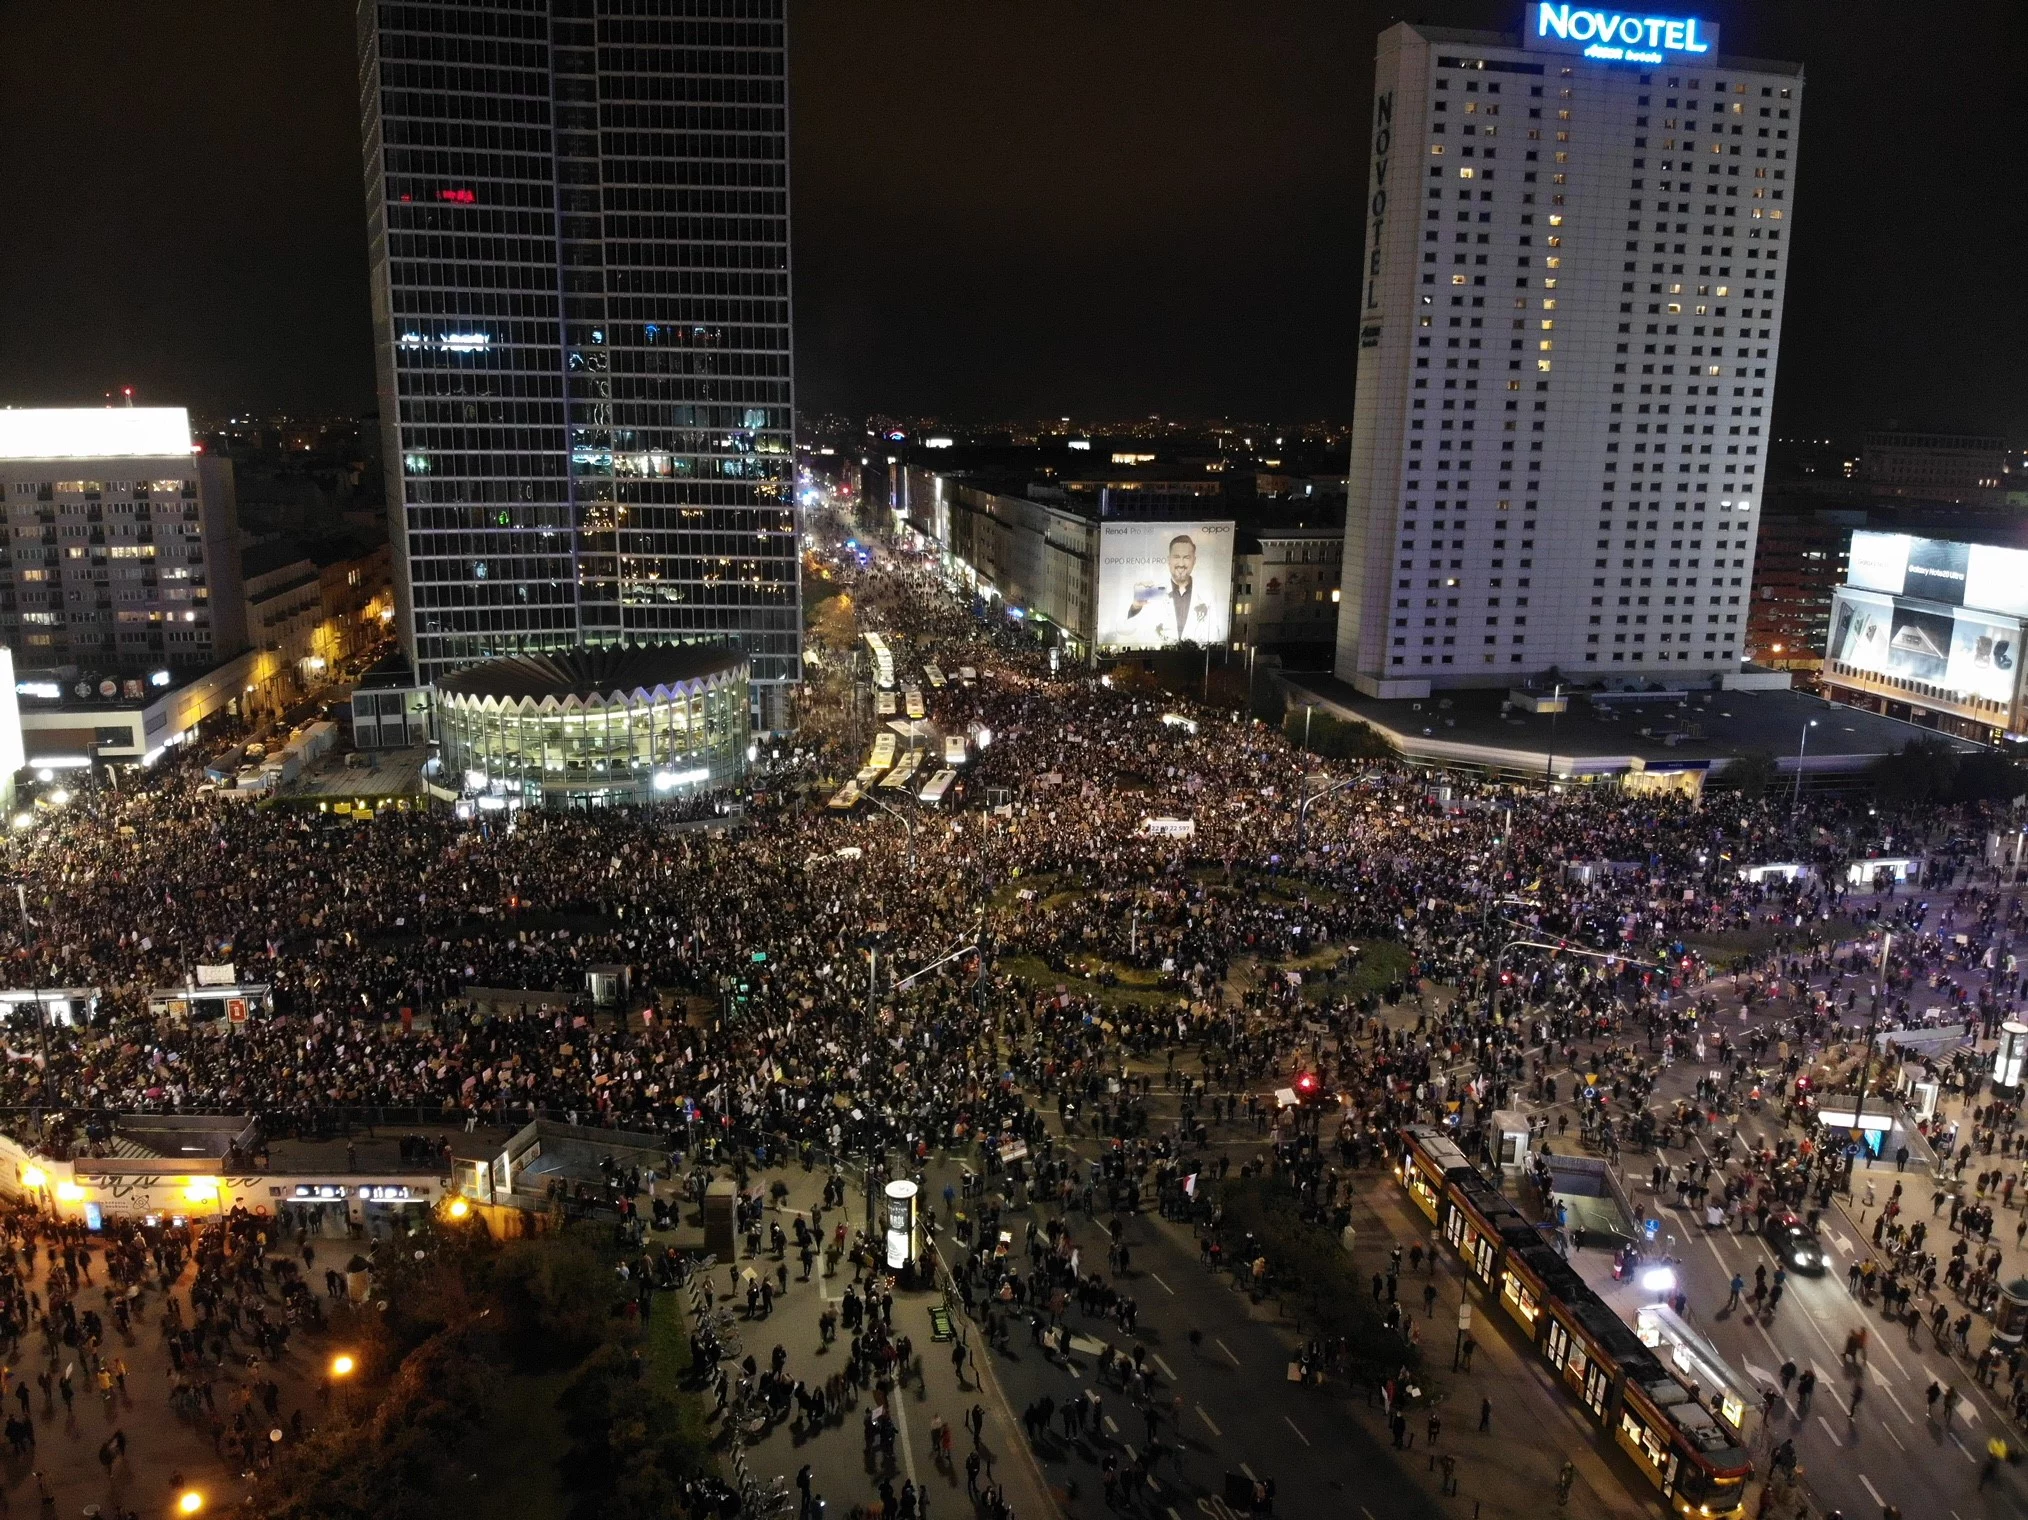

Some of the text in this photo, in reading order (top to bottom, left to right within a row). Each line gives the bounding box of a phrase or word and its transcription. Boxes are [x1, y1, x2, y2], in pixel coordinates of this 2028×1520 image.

[1539, 2, 1707, 53] NOVOTEL
[1367, 92, 1393, 309] NOVOTEL
[1105, 527, 1128, 535] Reno4
[1104, 557, 1125, 565] OPPO
[1151, 557, 1167, 565] PRO
